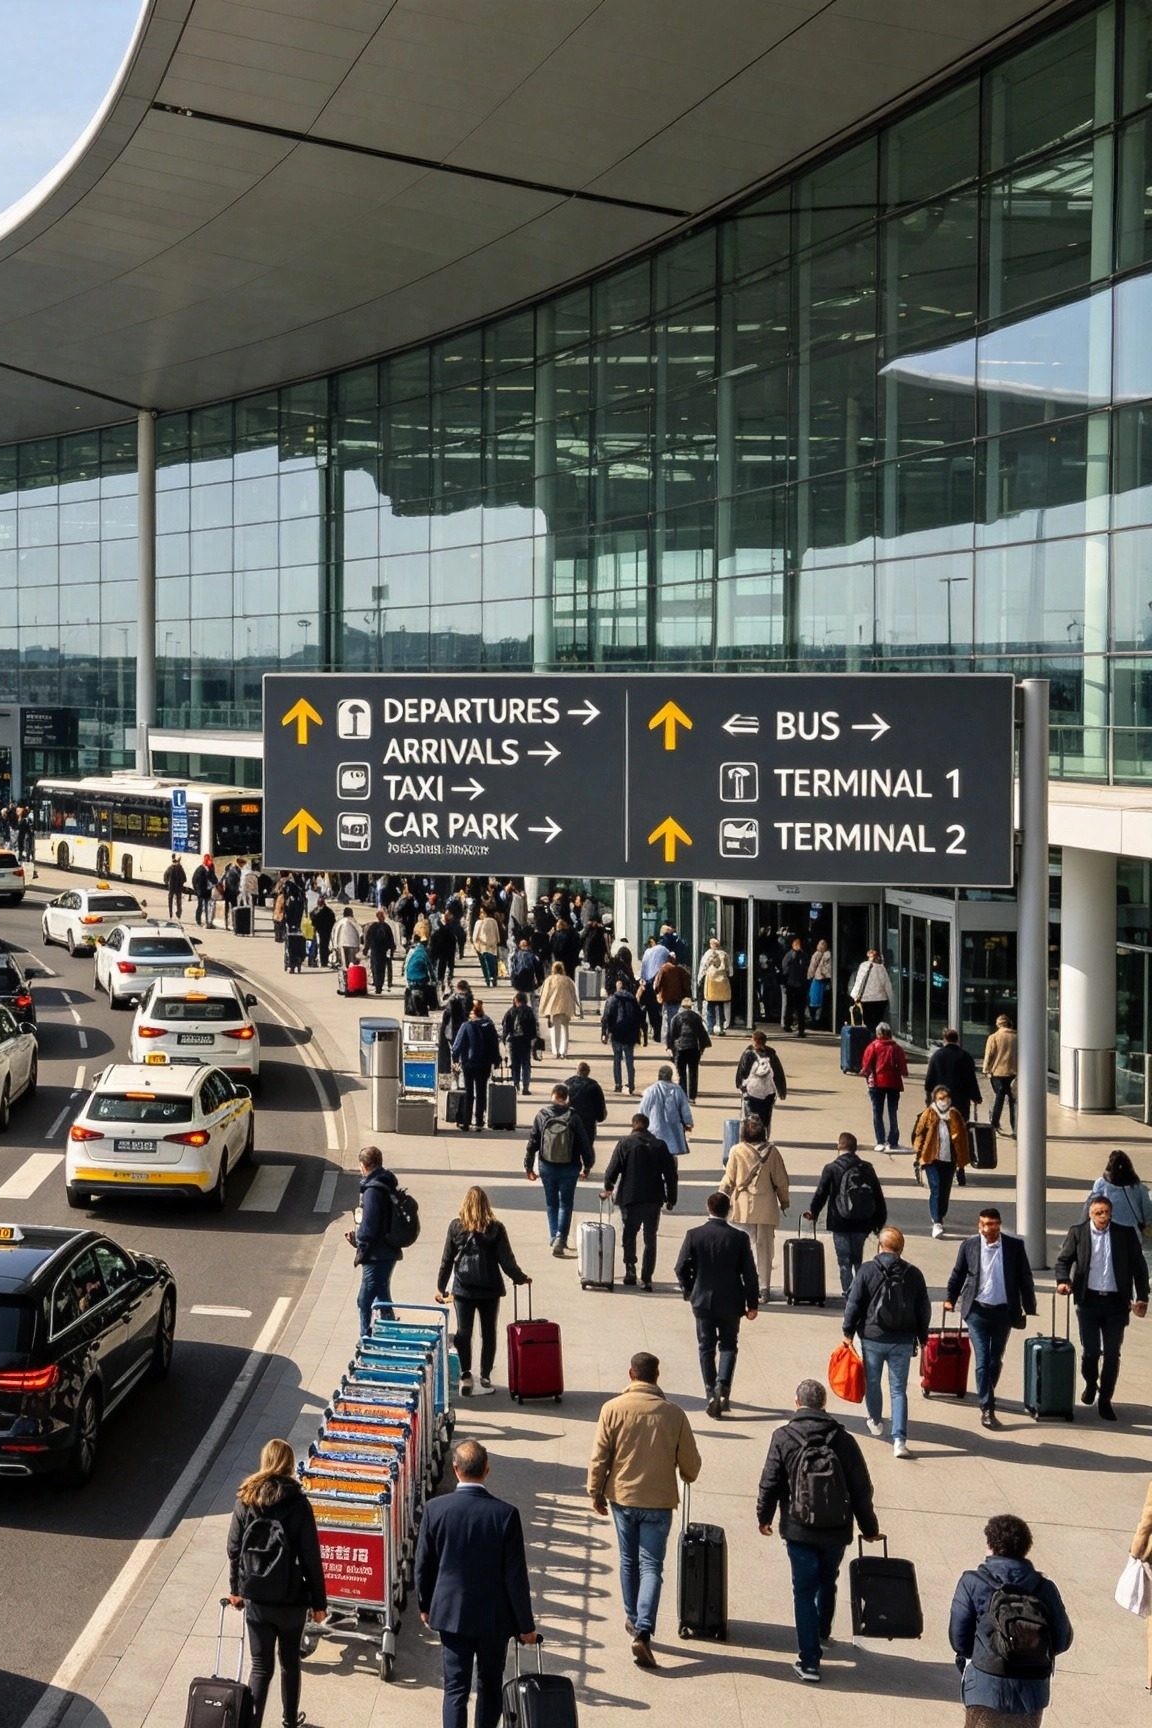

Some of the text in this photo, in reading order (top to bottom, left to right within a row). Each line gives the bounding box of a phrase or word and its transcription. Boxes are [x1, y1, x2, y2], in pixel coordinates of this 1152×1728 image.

[384, 697, 560, 725] DEPARTURES
[776, 711, 841, 742] BUS
[382, 737, 520, 766] ARRIVALS
[383, 775, 444, 802] TAXI
[773, 768, 961, 799] TERMINAL 1
[384, 811, 520, 841] CAR PARK
[773, 822, 968, 855] TERMINAL 2
